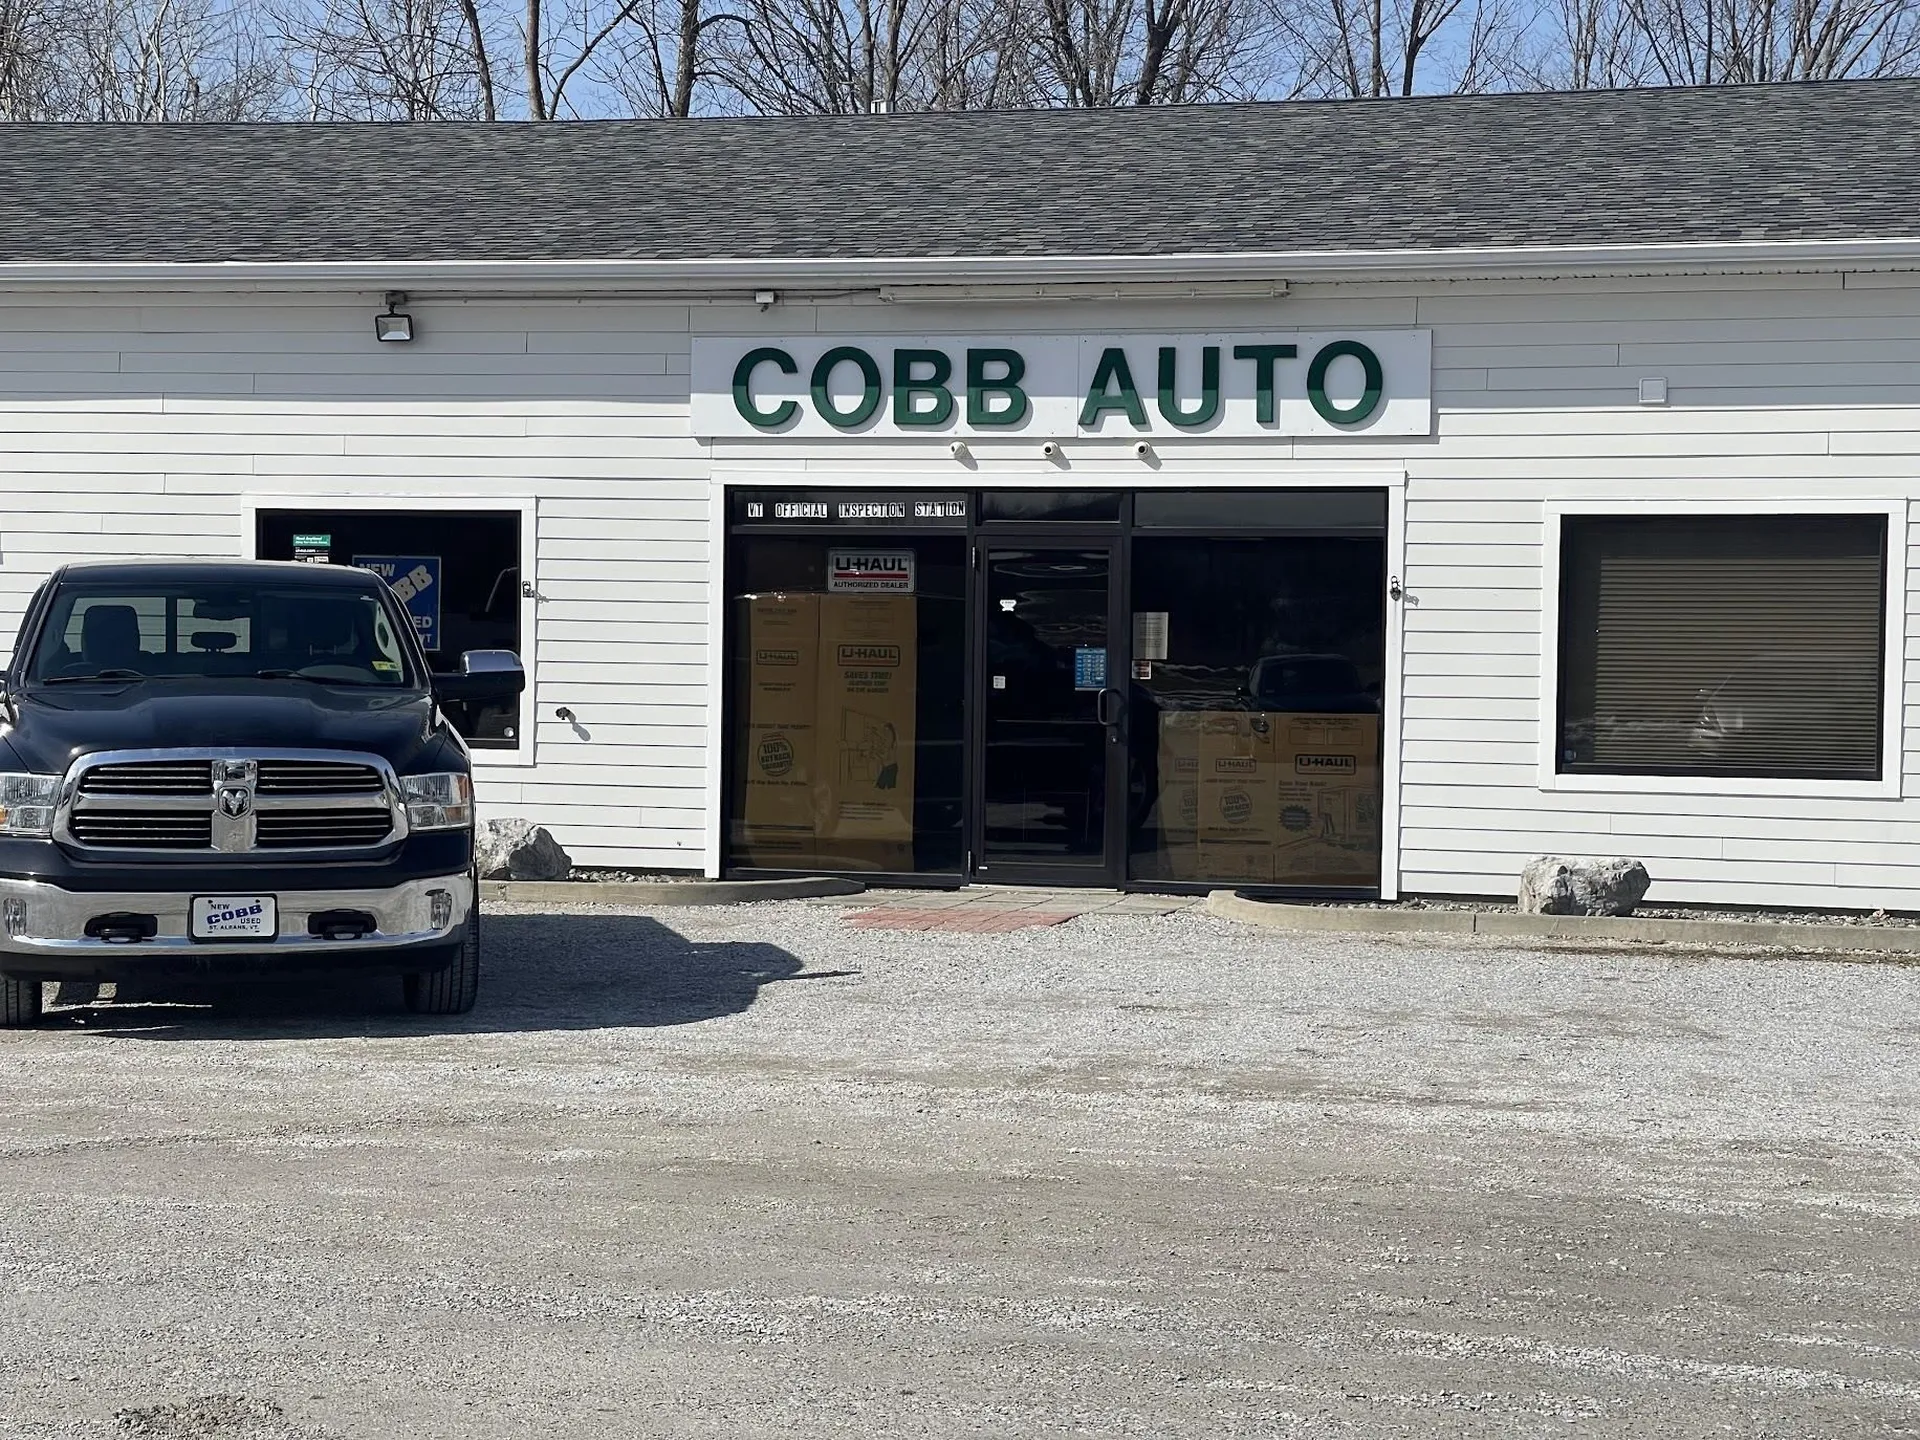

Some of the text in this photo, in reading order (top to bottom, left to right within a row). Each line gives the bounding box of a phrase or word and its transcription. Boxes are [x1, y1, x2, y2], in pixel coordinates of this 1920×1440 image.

[731, 339, 1384, 428] COBB AUTO
[748, 501, 965, 518] VT OFFICIAL INSPECTION STATION
[835, 557, 907, 571] U-HAUL
[833, 581, 879, 589] AUTHORIZED
[842, 648, 897, 659] U-HAUL
[1299, 758, 1352, 768] U-HAUL
[206, 904, 263, 924] COBB
